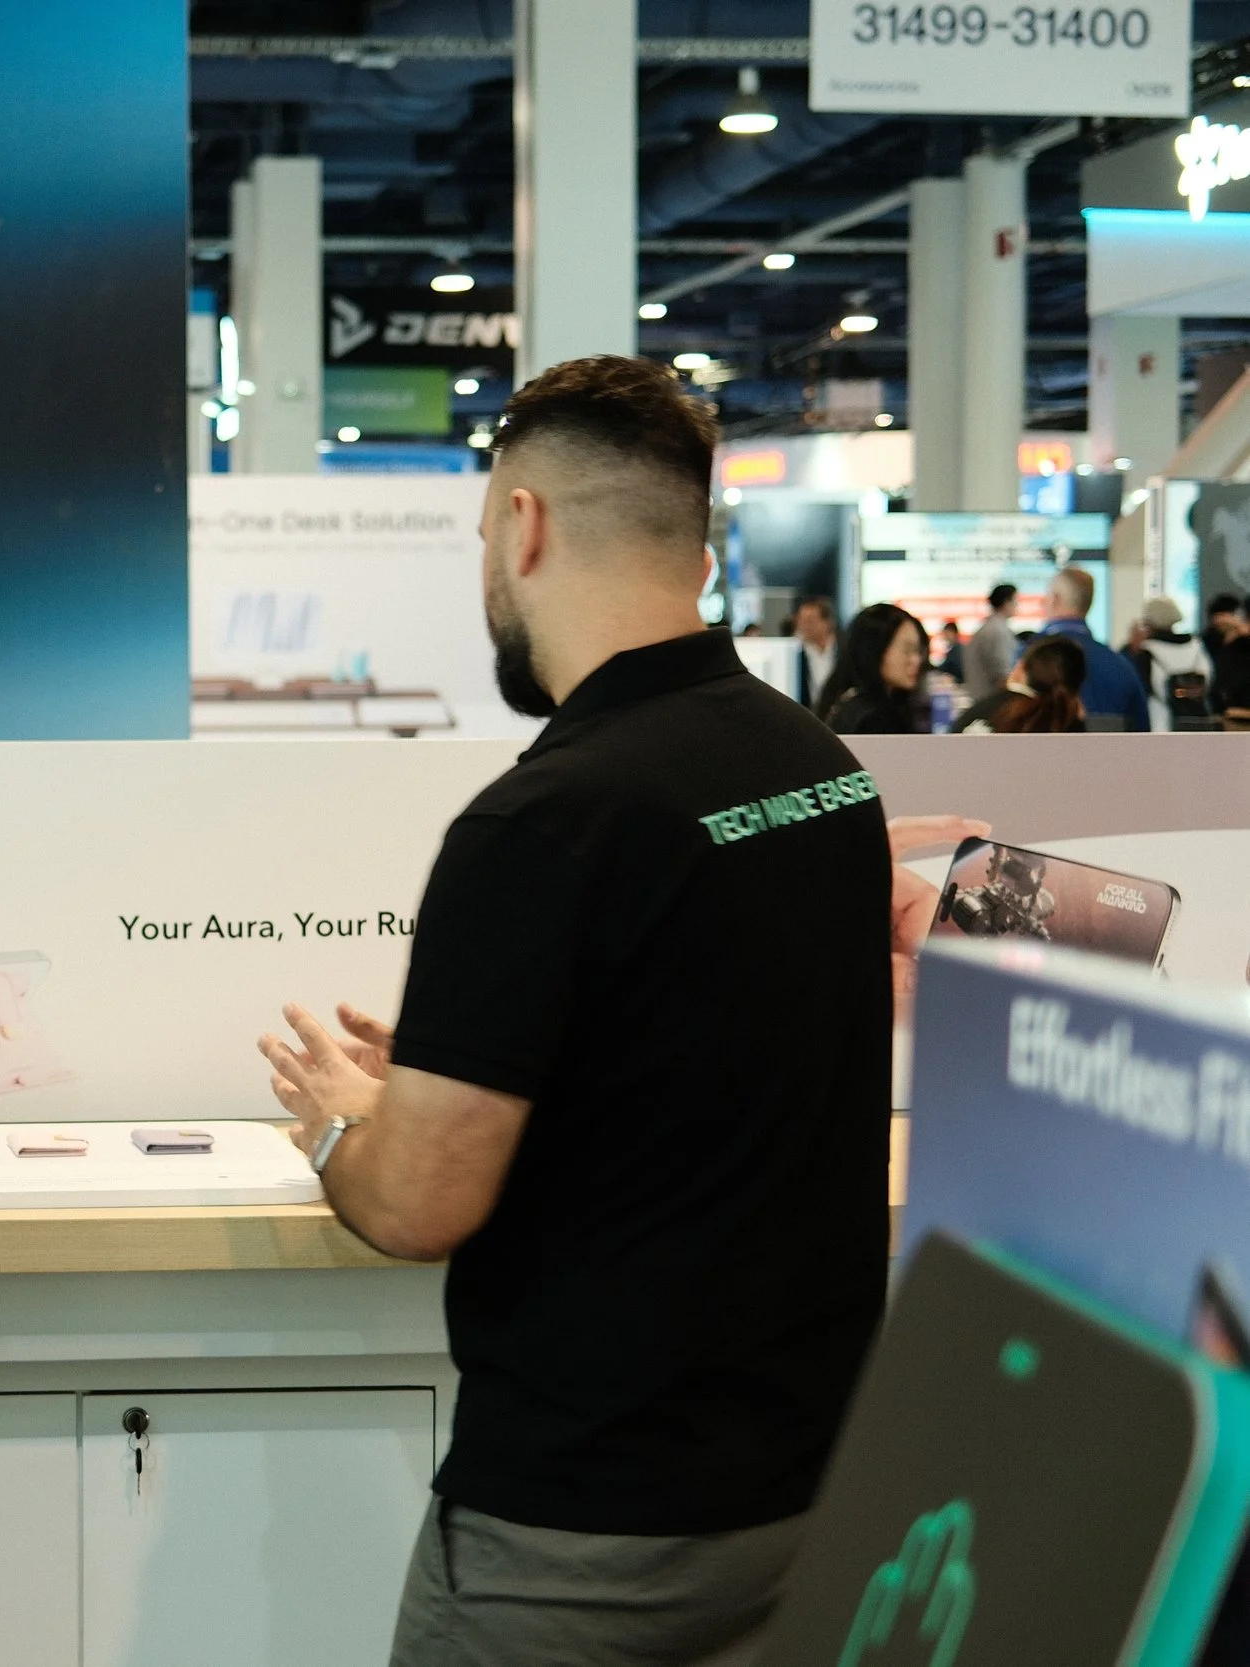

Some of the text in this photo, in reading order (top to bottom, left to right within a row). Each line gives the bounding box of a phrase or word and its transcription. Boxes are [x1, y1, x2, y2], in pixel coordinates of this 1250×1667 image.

[853, 3, 1149, 49] 31499-31400
[280, 508, 340, 535] Desk
[349, 508, 457, 535] Solution
[698, 770, 878, 845] TECH MADE EASIE
[1096, 891, 1147, 914] MANKIND
[119, 914, 193, 940] Your
[202, 914, 283, 942] Aura,
[294, 912, 367, 938] Your
[1009, 998, 1193, 1140] Effortless
